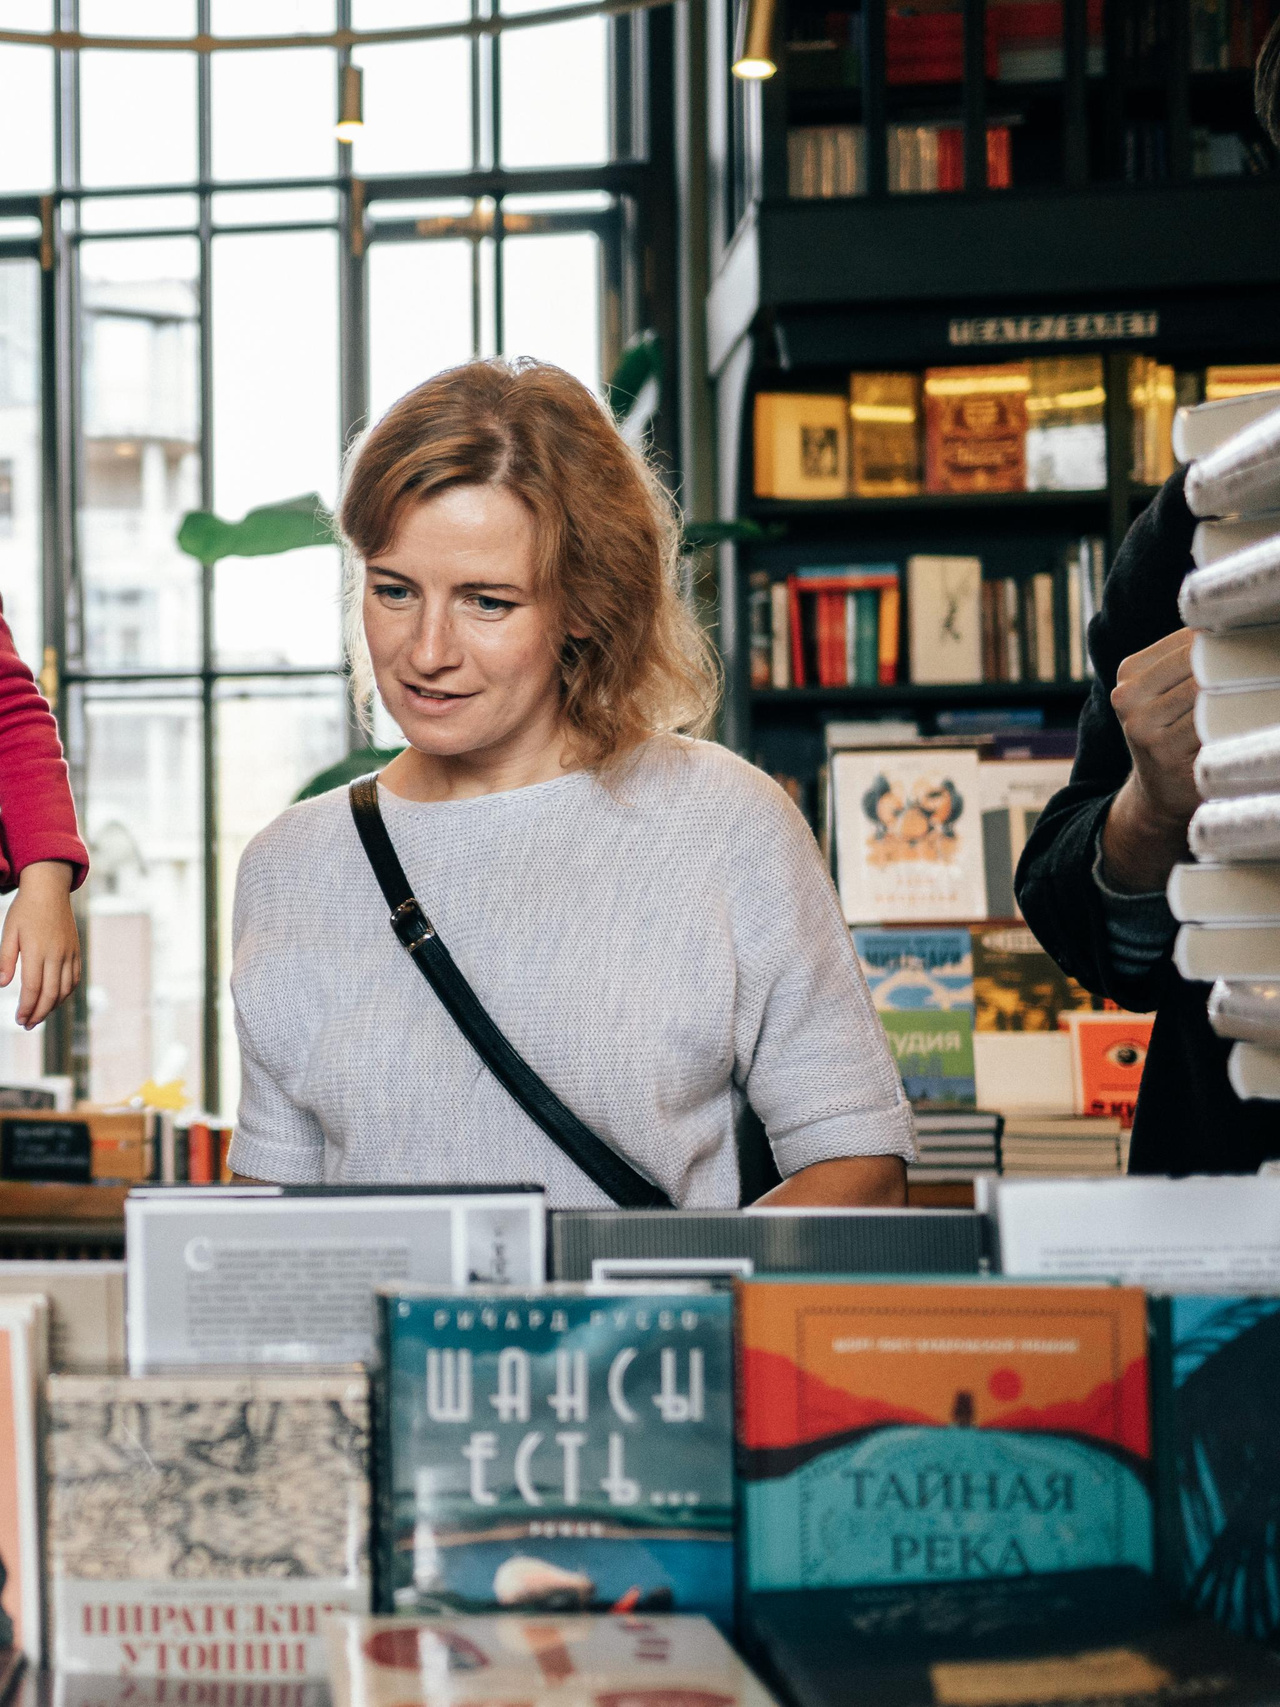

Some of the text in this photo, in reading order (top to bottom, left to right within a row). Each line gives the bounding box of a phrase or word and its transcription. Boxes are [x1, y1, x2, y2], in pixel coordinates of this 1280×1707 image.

[426, 1346, 705, 1423] ШАНСЫ
[840, 1463, 1076, 1513] ТАЙНАЯ
[890, 1533, 1032, 1578] РЕКА
[82, 1603, 352, 1634] ПИРАТСКИ
